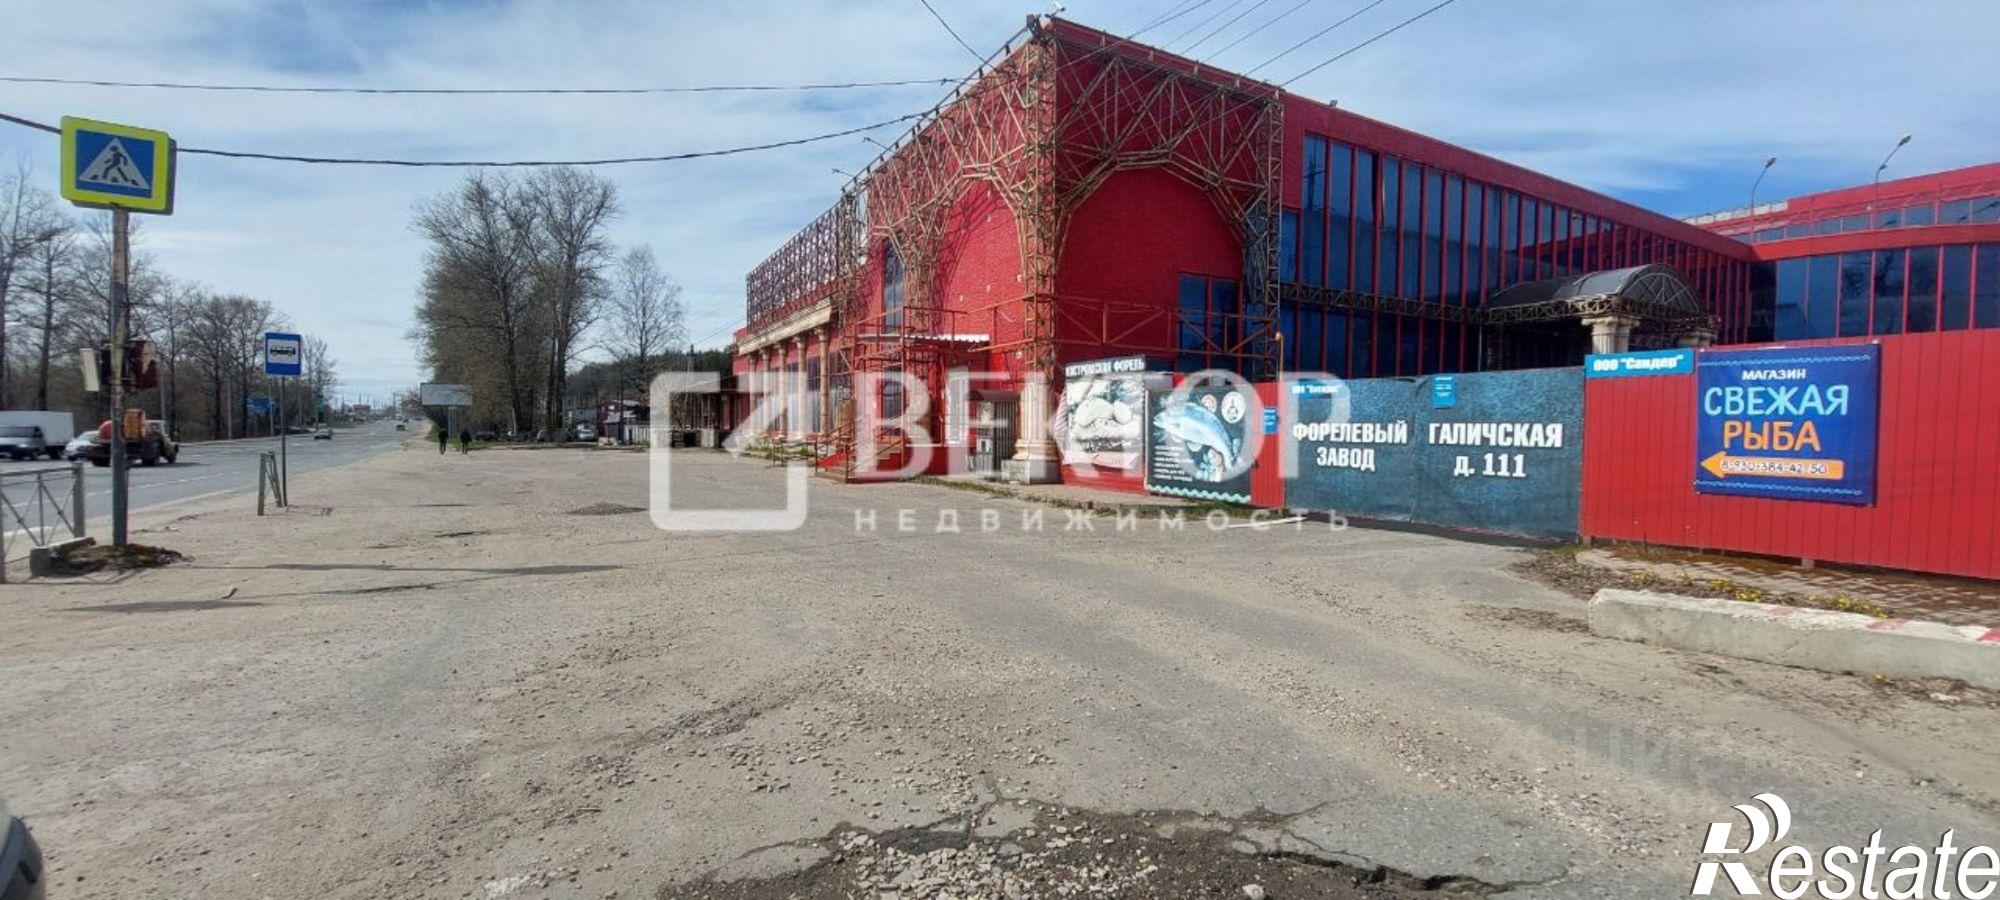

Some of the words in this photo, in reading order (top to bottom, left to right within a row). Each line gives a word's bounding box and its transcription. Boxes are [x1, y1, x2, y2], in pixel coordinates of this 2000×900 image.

[1113, 358, 1145, 371] ФОРЕЛЬ
[1742, 369, 1807, 381] МАГАЗИН
[1704, 385, 1849, 416] СВЕЖАЯ
[1292, 420, 1408, 444] ФОРЕЛЕВЫЙ
[1429, 422, 1564, 448] ГАЛИЧСКАЯ
[1722, 420, 1822, 452] РЫБА
[1316, 447, 1376, 471] ЗАВОД
[1482, 452, 1526, 478] 111
